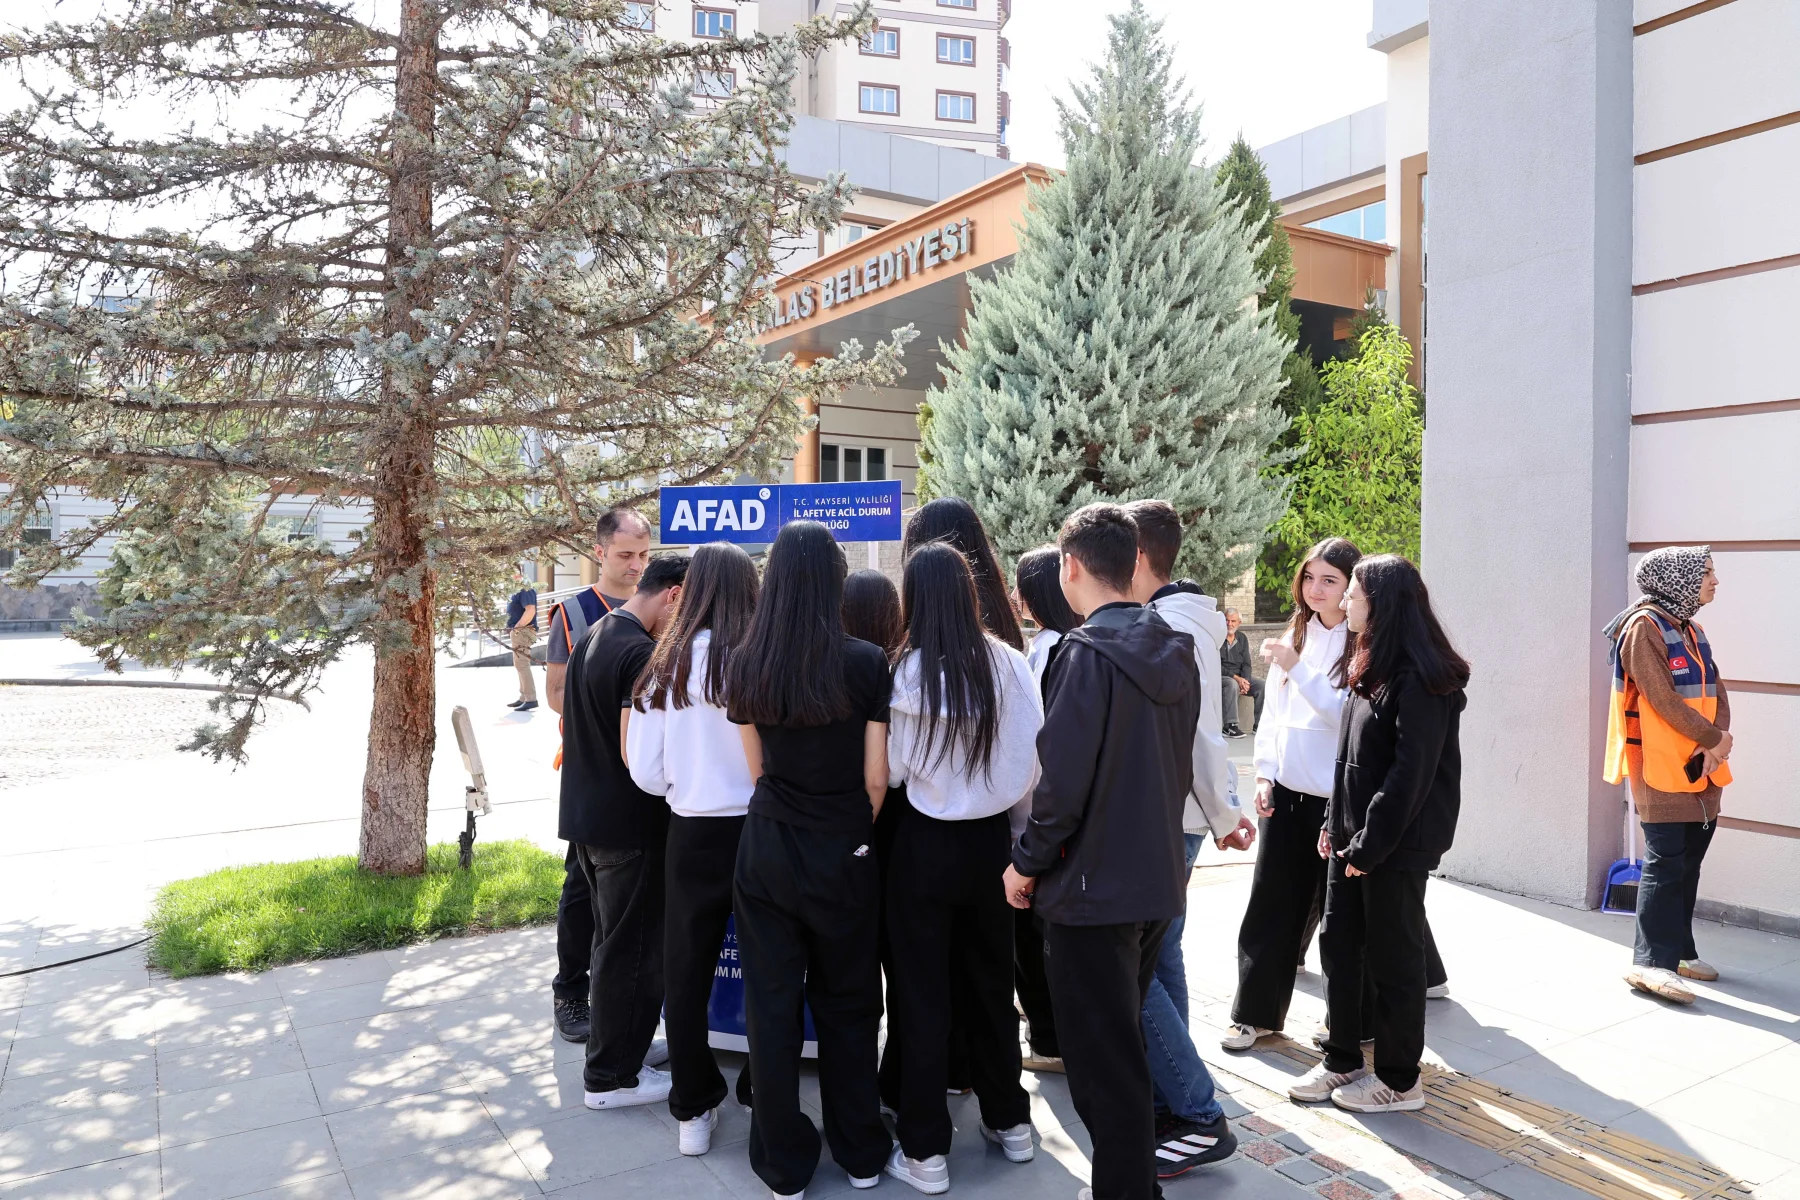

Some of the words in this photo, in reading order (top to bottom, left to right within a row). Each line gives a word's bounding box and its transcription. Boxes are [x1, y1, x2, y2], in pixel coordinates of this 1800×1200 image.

[752, 286, 813, 335] LAS
[794, 498, 810, 506] T.C.
[815, 496, 850, 505] KAYSERİ
[855, 494, 892, 504] VALİLİĞİ
[669, 500, 766, 532] AFAD
[793, 508, 801, 518] İL
[803, 509, 824, 518] AFET
[825, 508, 836, 517] VE
[838, 507, 857, 516] ACİL
[858, 507, 891, 516] DURUM
